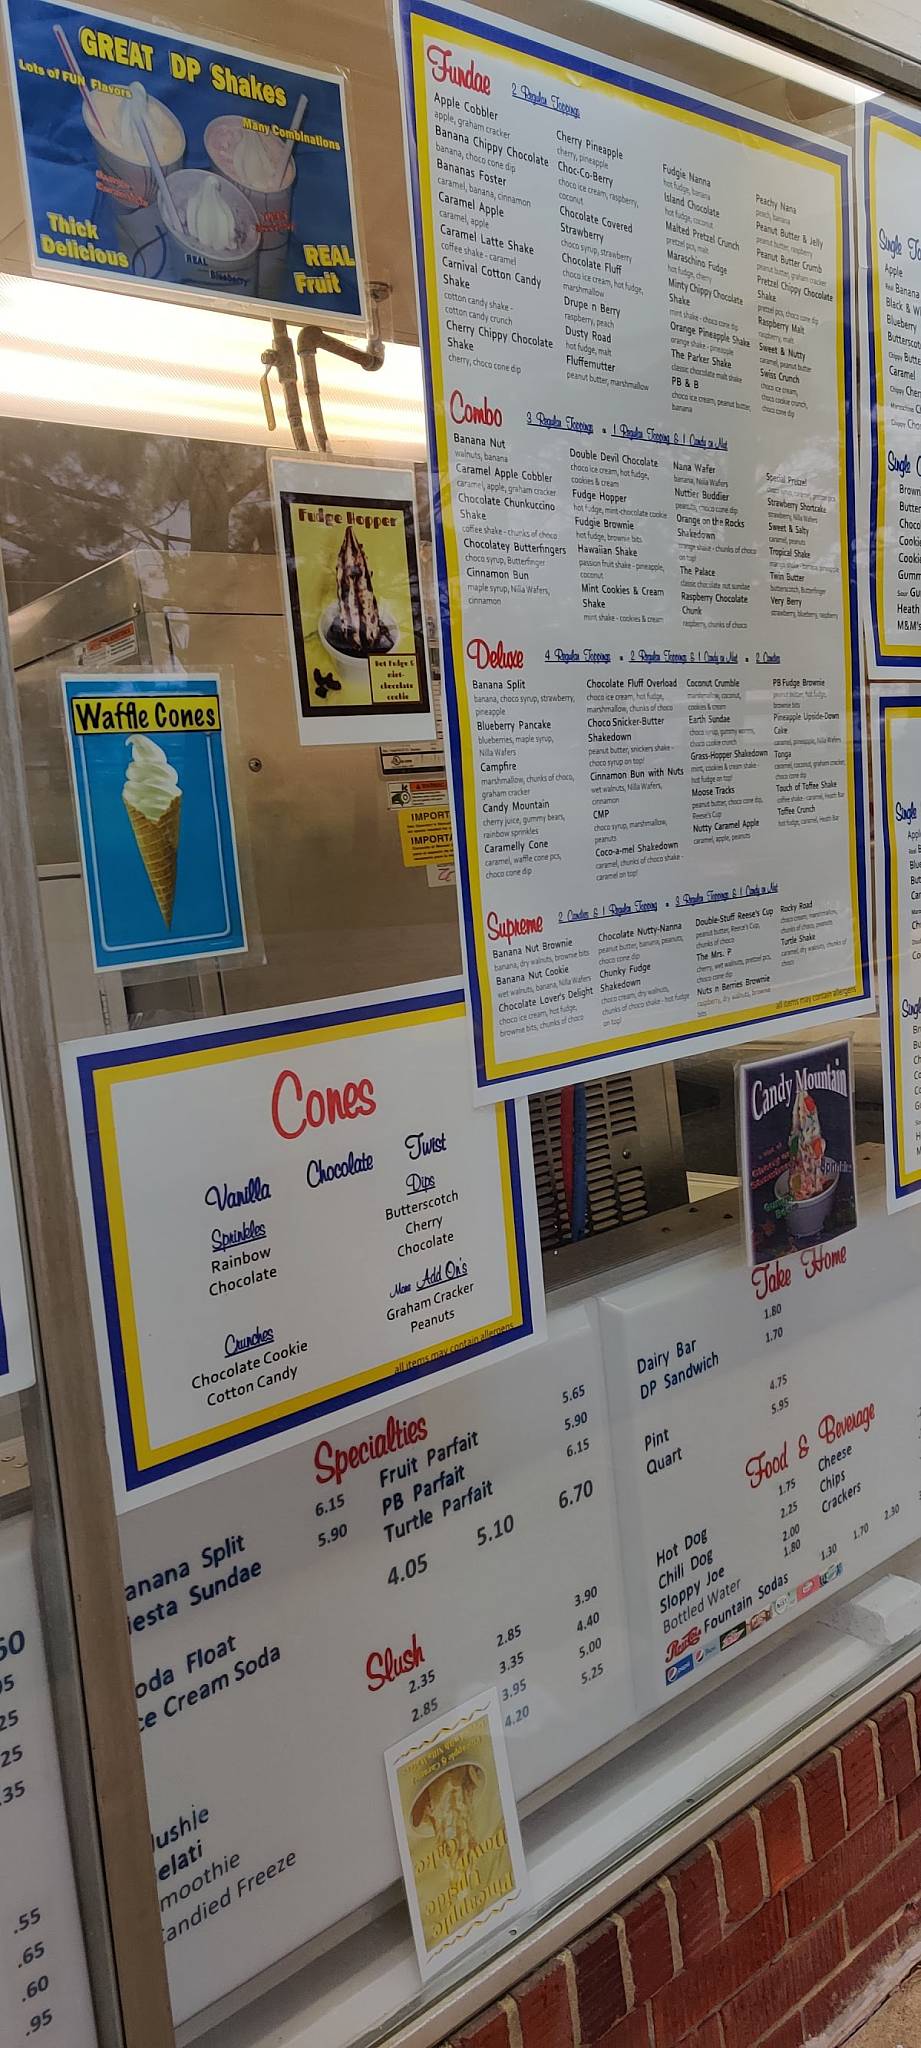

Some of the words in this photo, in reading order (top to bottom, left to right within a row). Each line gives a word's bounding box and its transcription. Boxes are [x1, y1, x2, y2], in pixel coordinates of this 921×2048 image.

[18, 59, 46, 79] Lots
[48, 65, 60, 80] of
[61, 68, 86, 87] FUN
[90, 78, 133, 98] Flavors
[79, 25, 154, 73] GREAT
[168, 50, 202, 82] DP
[210, 61, 288, 108] Shakes
[426, 44, 491, 96] Fundae
[434, 92, 460, 109] Apple
[464, 101, 498, 120] Cobbler
[241, 117, 269, 134] Many
[271, 122, 341, 151] Combinations
[435, 125, 469, 144] Banana
[473, 136, 503, 156] Chippy
[506, 146, 549, 167] Chocolate
[556, 130, 582, 149] Cherry
[586, 139, 623, 160] Pineapple
[558, 161, 613, 188] Choc-Co-Berry
[46, 212, 99, 241] Thick
[666, 221, 689, 236] Malted
[692, 228, 715, 243] Pretzel
[717, 237, 739, 251] Crunch
[40, 233, 129, 269] Delicious
[303, 245, 356, 267] REAL
[879, 228, 902, 259] Single
[294, 272, 340, 294] Fruit
[442, 256, 477, 273] Carnival
[481, 265, 511, 280] Cotton
[515, 272, 541, 289] Candy
[885, 263, 903, 278] Apple
[449, 389, 503, 428] Combo
[454, 433, 485, 446] Banana
[490, 438, 505, 449] Nut
[673, 461, 692, 471] Nana
[694, 464, 715, 474] Wafer
[572, 488, 596, 502] Fudge
[599, 491, 627, 504] Hopper
[298, 507, 344, 526] Fudge
[346, 511, 398, 529] Hopper
[466, 638, 524, 669] Deluxe
[472, 680, 503, 689] Banana
[507, 679, 525, 692] Split
[75, 699, 151, 733] Waffle
[155, 704, 216, 729] Cones
[480, 761, 516, 773] Campfire
[482, 802, 508, 814] Candy
[512, 799, 549, 810] Mountain
[593, 809, 609, 819] CMP
[780, 904, 797, 913] Rocky
[799, 900, 812, 909] Road
[487, 911, 544, 944] Supreme
[492, 948, 522, 959] Banana
[525, 944, 539, 953] Nut
[542, 938, 573, 950] Brownie
[272, 1069, 377, 1140] Cones
[751, 1075, 792, 1121] Candy
[795, 1058, 848, 1098] Mountain
[404, 1132, 447, 1160] Twist
[307, 1151, 373, 1188] Chocolate
[406, 1173, 436, 1195] Dips
[205, 1176, 271, 1211] Vanilla
[385, 1190, 458, 1220] Butterscotch
[211, 1220, 267, 1253] Sprinkles
[405, 1216, 442, 1234] Cherry
[211, 1248, 271, 1273] Rainbow
[397, 1233, 453, 1257] Chocolate
[209, 1268, 277, 1296] Chocolate
[416, 1265, 447, 1291] Add
[440, 1257, 468, 1284] On's
[752, 1264, 791, 1300] Take
[800, 1244, 848, 1279] Home
[387, 1298, 431, 1320] Graham
[434, 1283, 474, 1303] Cracker
[411, 1310, 454, 1333] Peanuts
[766, 1327, 783, 1343] 1.70
[224, 1326, 274, 1358] Crunches
[637, 1351, 669, 1374] Dairy
[676, 1340, 696, 1358] Bar
[764, 1303, 781, 1319] 1.80
[192, 1359, 260, 1388] Chocolate
[264, 1341, 307, 1364] Cookie
[640, 1380, 656, 1399] DP
[664, 1351, 718, 1389] Sandwich
[207, 1383, 254, 1406] Cotton
[257, 1365, 297, 1388] Candy
[562, 1384, 585, 1403] 5.65
[565, 1411, 587, 1431] 5.90
[645, 1429, 669, 1451] Pint
[770, 1374, 787, 1390] 4.75
[313, 1415, 428, 1485] Specialties
[566, 1438, 589, 1457] 6.15
[647, 1447, 682, 1474] Quart
[771, 1397, 789, 1415] 5.95
[745, 1442, 789, 1489] Food
[798, 1435, 809, 1458] &
[817, 1404, 875, 1444] Beverage
[380, 1457, 418, 1488] Fruit
[427, 1431, 478, 1466] Parfait
[818, 1445, 852, 1471] Cheese
[382, 1492, 404, 1516] PB
[413, 1465, 465, 1502] Parfait
[820, 1470, 845, 1492] Chips
[822, 1482, 861, 1513] Crackers
[315, 1493, 344, 1516] 6.15
[383, 1509, 433, 1542] Turtle
[442, 1480, 493, 1517] Parfait
[318, 1523, 347, 1547] 5.90
[388, 1553, 427, 1584] 4.05
[477, 1514, 514, 1546] 5.10
[559, 1480, 593, 1508] 6.70
[656, 1543, 678, 1567] Hot
[684, 1528, 707, 1550] Dog
[779, 1478, 795, 1495] 1.75
[659, 1563, 684, 1589] Chili
[690, 1549, 713, 1570] Dog
[781, 1501, 797, 1519] 2.25
[124, 1562, 189, 1601] anana
[201, 1535, 245, 1568] Split
[660, 1580, 700, 1614] Sloppy
[706, 1567, 724, 1586] Joe
[782, 1523, 800, 1542] 2.00
[124, 1600, 178, 1638] iesta
[189, 1562, 261, 1606] Sundae
[663, 1597, 704, 1634] Bottled
[707, 1579, 740, 1606] Water
[784, 1539, 800, 1557] 1.80
[704, 1596, 752, 1633] Fountain
[758, 1573, 788, 1599] Sodas
[134, 1668, 174, 1703] oda
[186, 1635, 236, 1673] Float
[364, 1635, 424, 1691] Slush
[164, 1674, 229, 1717] Cream
[234, 1646, 280, 1681] Soda
[151, 1805, 209, 1854] lushie
[158, 1840, 202, 1880] elati
[160, 1854, 239, 1912] moothie
[163, 1886, 232, 1943] andied
[237, 1852, 296, 1898] Freeze
